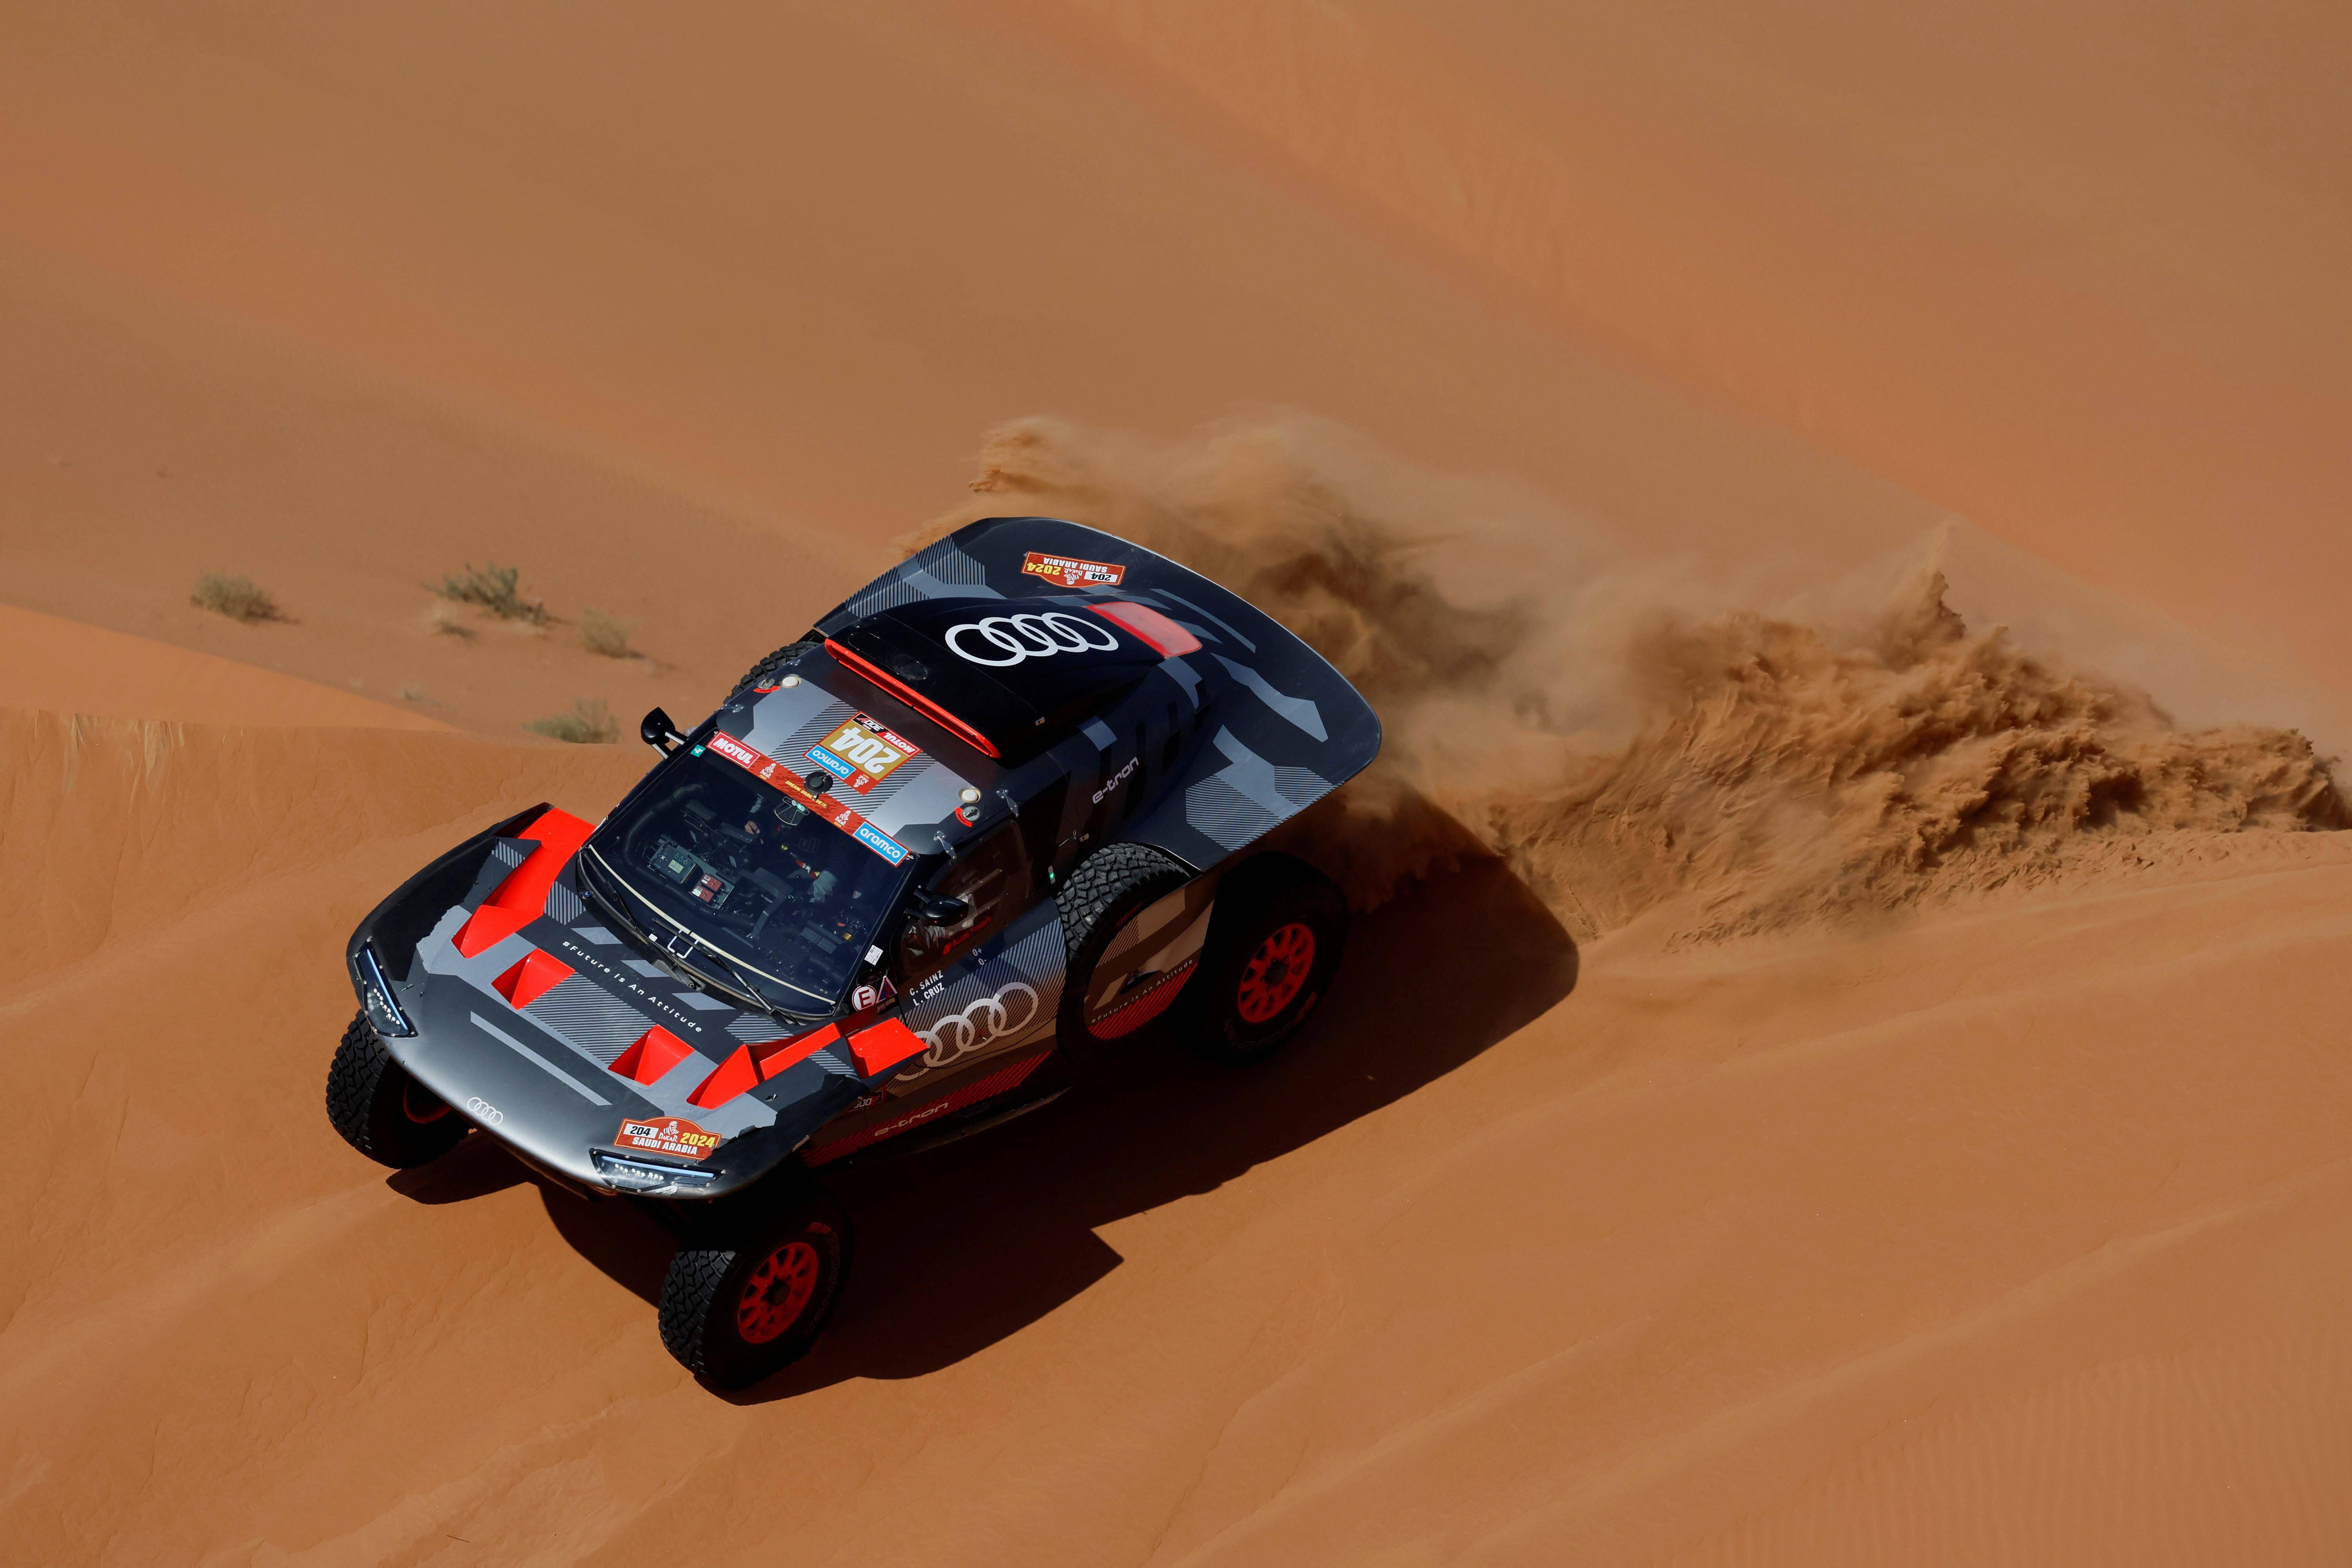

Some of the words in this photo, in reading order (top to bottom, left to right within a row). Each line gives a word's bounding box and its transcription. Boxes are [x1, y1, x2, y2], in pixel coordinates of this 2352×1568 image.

[1027, 562, 1062, 575] 2024
[1043, 557, 1078, 568] ARABIA
[1063, 567, 1083, 576] DAKAR
[1079, 563, 1108, 573] SAUDI
[1091, 572, 1112, 581] 204
[856, 717, 884, 732] 300V
[713, 738, 753, 765] MOTUL
[830, 726, 901, 774] 204
[883, 732, 916, 753] MOTUL
[812, 750, 849, 775] aramco
[760, 768, 771, 779] DAKAR
[1092, 757, 1139, 804] e-tron
[785, 780, 802, 792] DREAM.
[800, 790, 813, 799] DARE.
[835, 815, 847, 826] DAKAR
[860, 828, 901, 858] aramco
[563, 941, 610, 973] #Future
[614, 973, 625, 983] Is
[628, 984, 644, 995] An
[648, 996, 702, 1033] Attitude
[909, 987, 918, 996] C.
[919, 969, 944, 990] SAINZ
[858, 989, 872, 1009] E
[913, 998, 924, 1006] L.
[924, 982, 945, 1000] CRUZ
[875, 1102, 948, 1137] e-tron
[630, 1126, 652, 1136] 204
[659, 1132, 678, 1142] DAKAR
[680, 1132, 716, 1148] 2024
[632, 1137, 661, 1149] SAUDI
[661, 1142, 698, 1155] ARABIA
